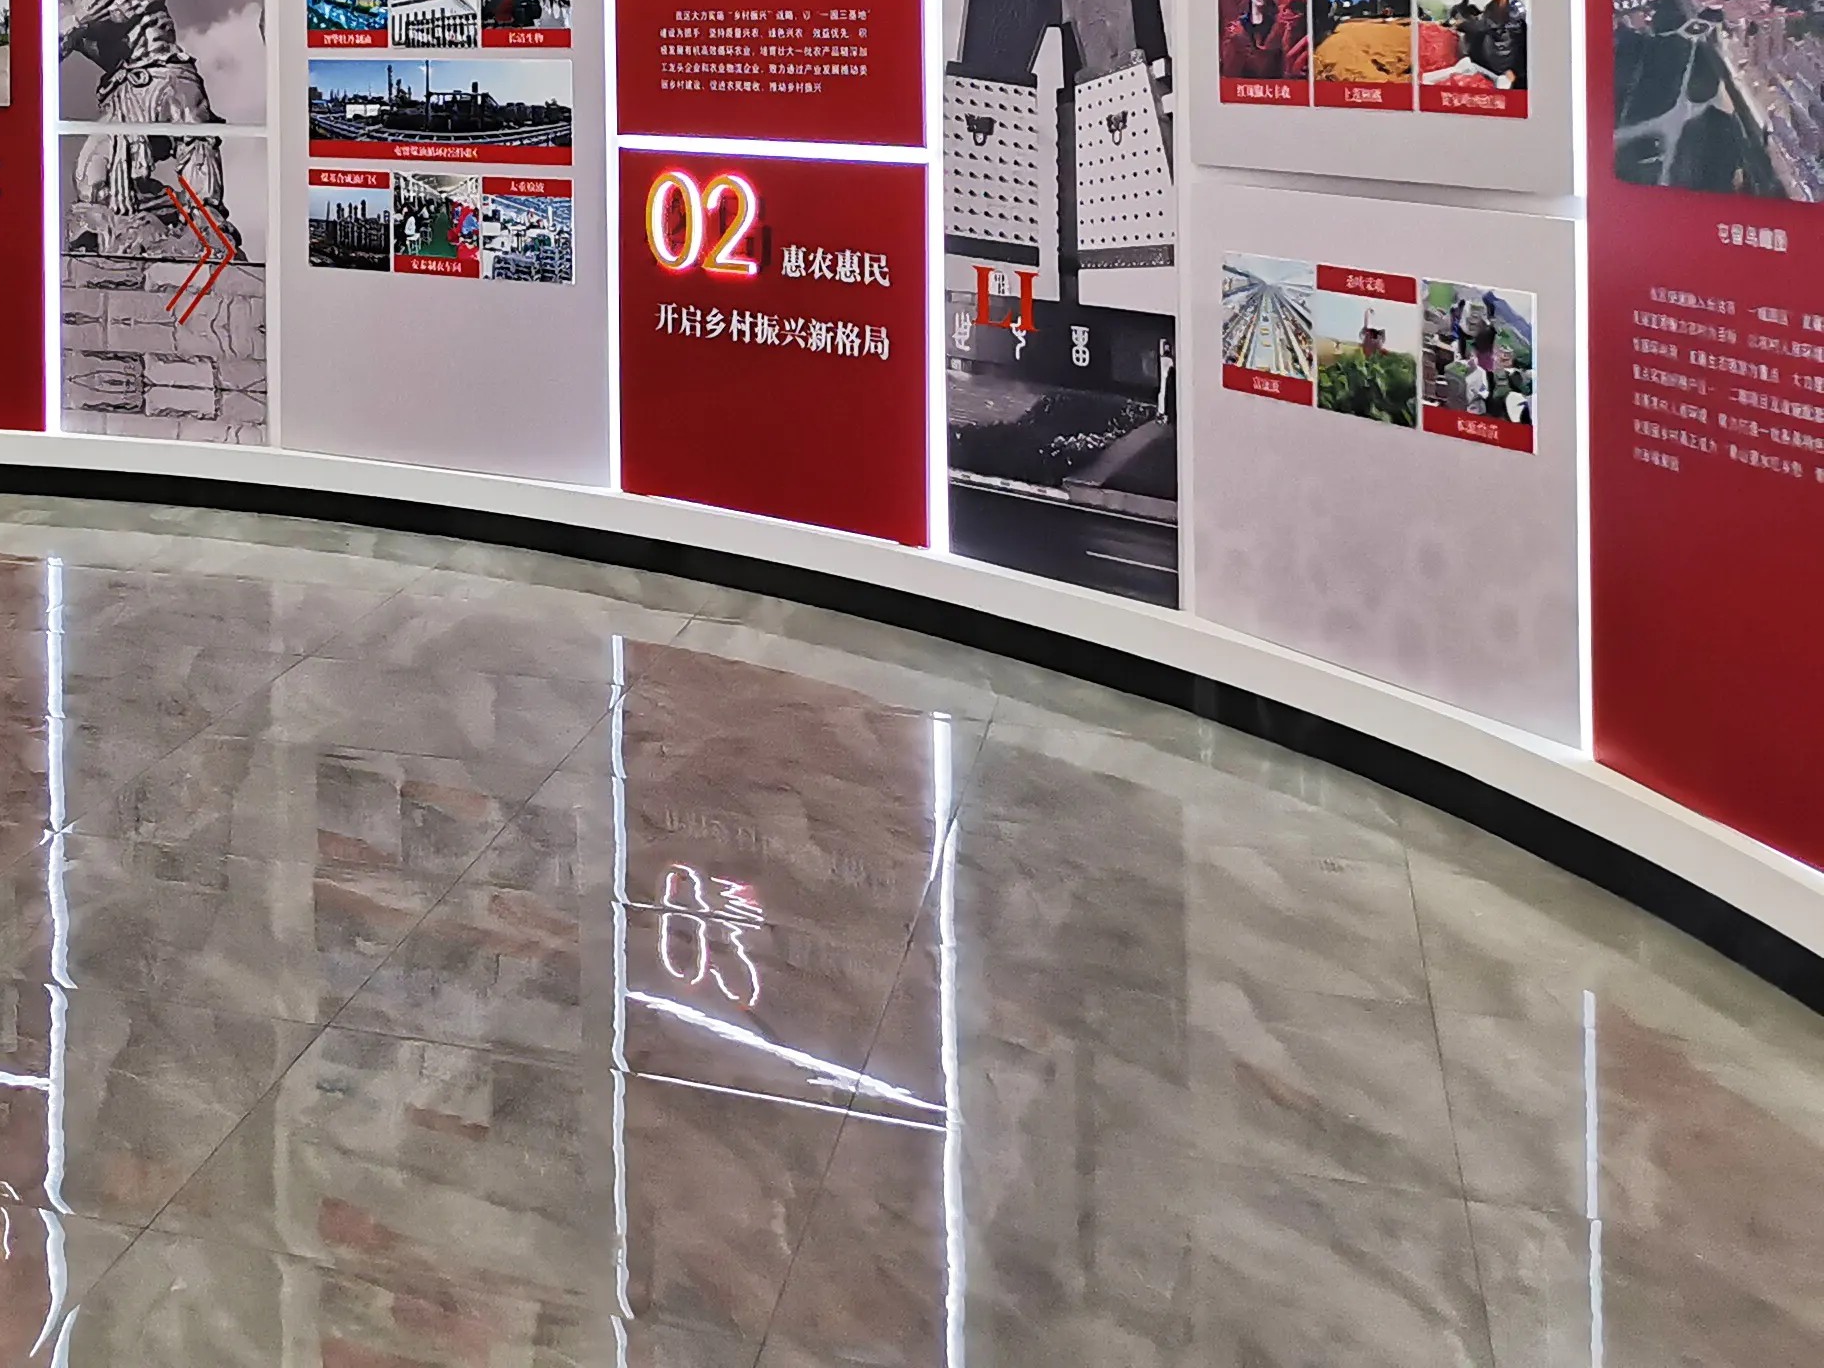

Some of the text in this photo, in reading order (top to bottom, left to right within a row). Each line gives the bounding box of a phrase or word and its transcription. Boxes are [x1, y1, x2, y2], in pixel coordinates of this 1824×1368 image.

[646, 171, 758, 275] 02
[781, 244, 891, 287] 惠农惠民
[971, 265, 1040, 332] LI
[655, 302, 891, 361] 开启乡村振兴新格局
